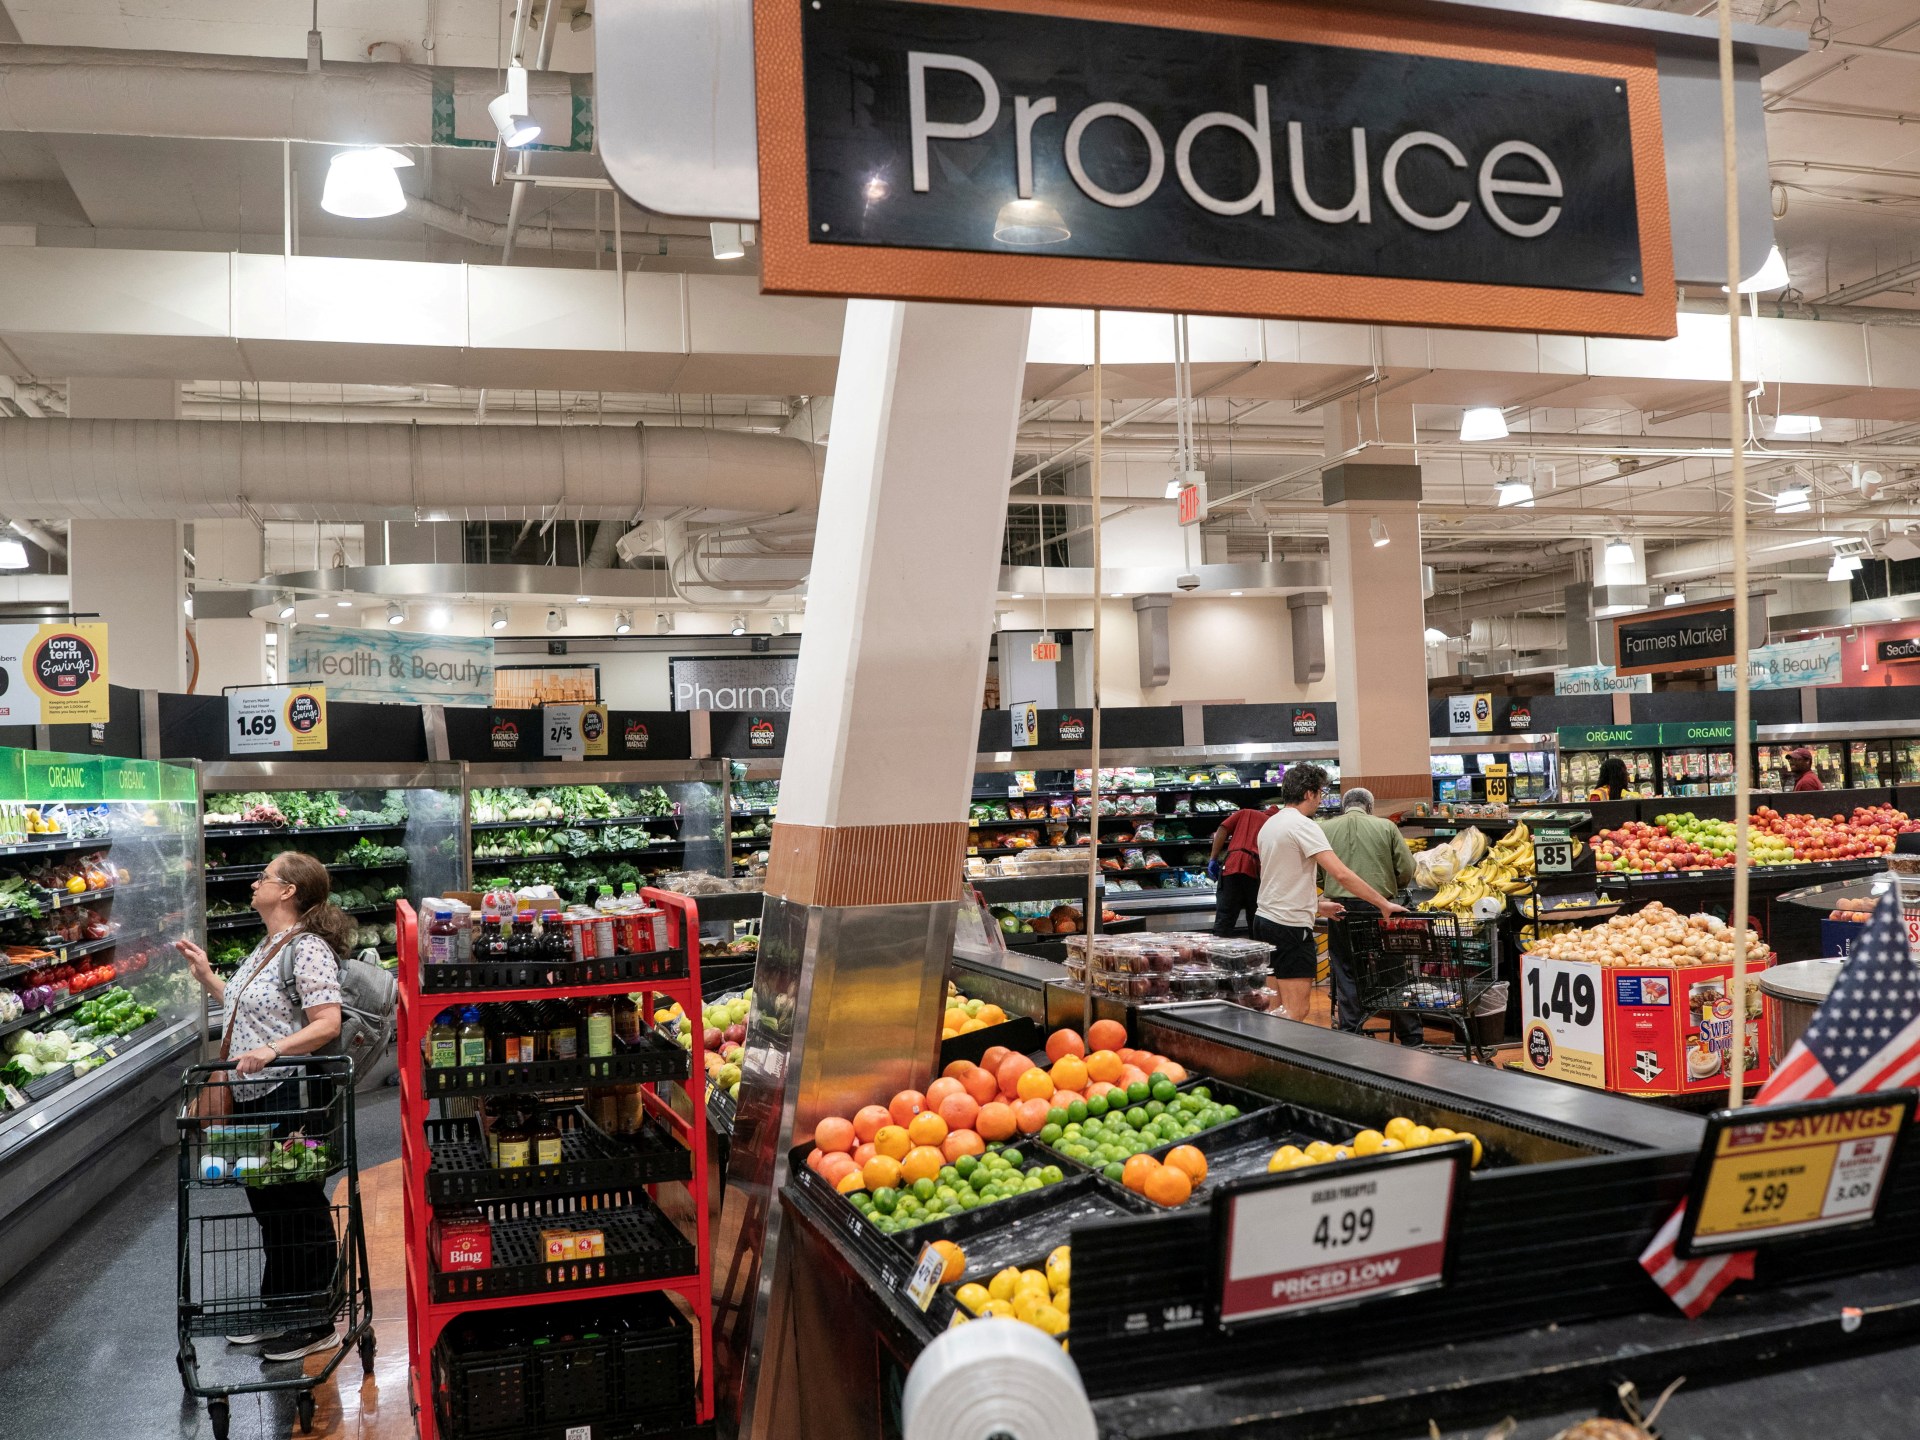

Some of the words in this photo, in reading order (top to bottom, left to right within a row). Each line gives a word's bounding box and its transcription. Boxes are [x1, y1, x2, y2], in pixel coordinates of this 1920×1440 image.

[908, 51, 1563, 237] Produce
[1180, 486, 1197, 523] EXIT
[49, 639, 76, 651] long
[1626, 634, 1677, 653] Farmers
[1680, 624, 1727, 646] Market
[49, 650, 81, 659] term
[1037, 645, 1057, 660] EXIT
[41, 660, 90, 676] Savings
[305, 648, 382, 677] Health
[389, 654, 405, 678] &
[412, 655, 485, 687] Beauty
[1770, 660, 1779, 674] &
[1783, 654, 1829, 673] Beauty
[1560, 679, 1591, 694] Health
[1593, 678, 1601, 691] &
[1604, 676, 1639, 690] Beauty
[237, 715, 276, 736] 1.69
[1453, 711, 1470, 723] 1.99
[1586, 731, 1633, 742] ORGANIC
[1687, 727, 1732, 738] ORGANIC
[49, 767, 85, 788] ORGANIC
[119, 770, 146, 789] ORGANIC
[1488, 779, 1505, 795] .69
[1537, 846, 1567, 865] .85
[1527, 967, 1595, 1026] 1.49
[1770, 1107, 1893, 1140] SAVINGS
[1743, 1183, 1788, 1213] 2.99
[1836, 1183, 1871, 1201] 3.00
[1313, 1207, 1374, 1248] 4.99
[450, 1251, 482, 1263] Bing
[1272, 1270, 1348, 1298] PRICED
[1350, 1258, 1400, 1281] LOW
